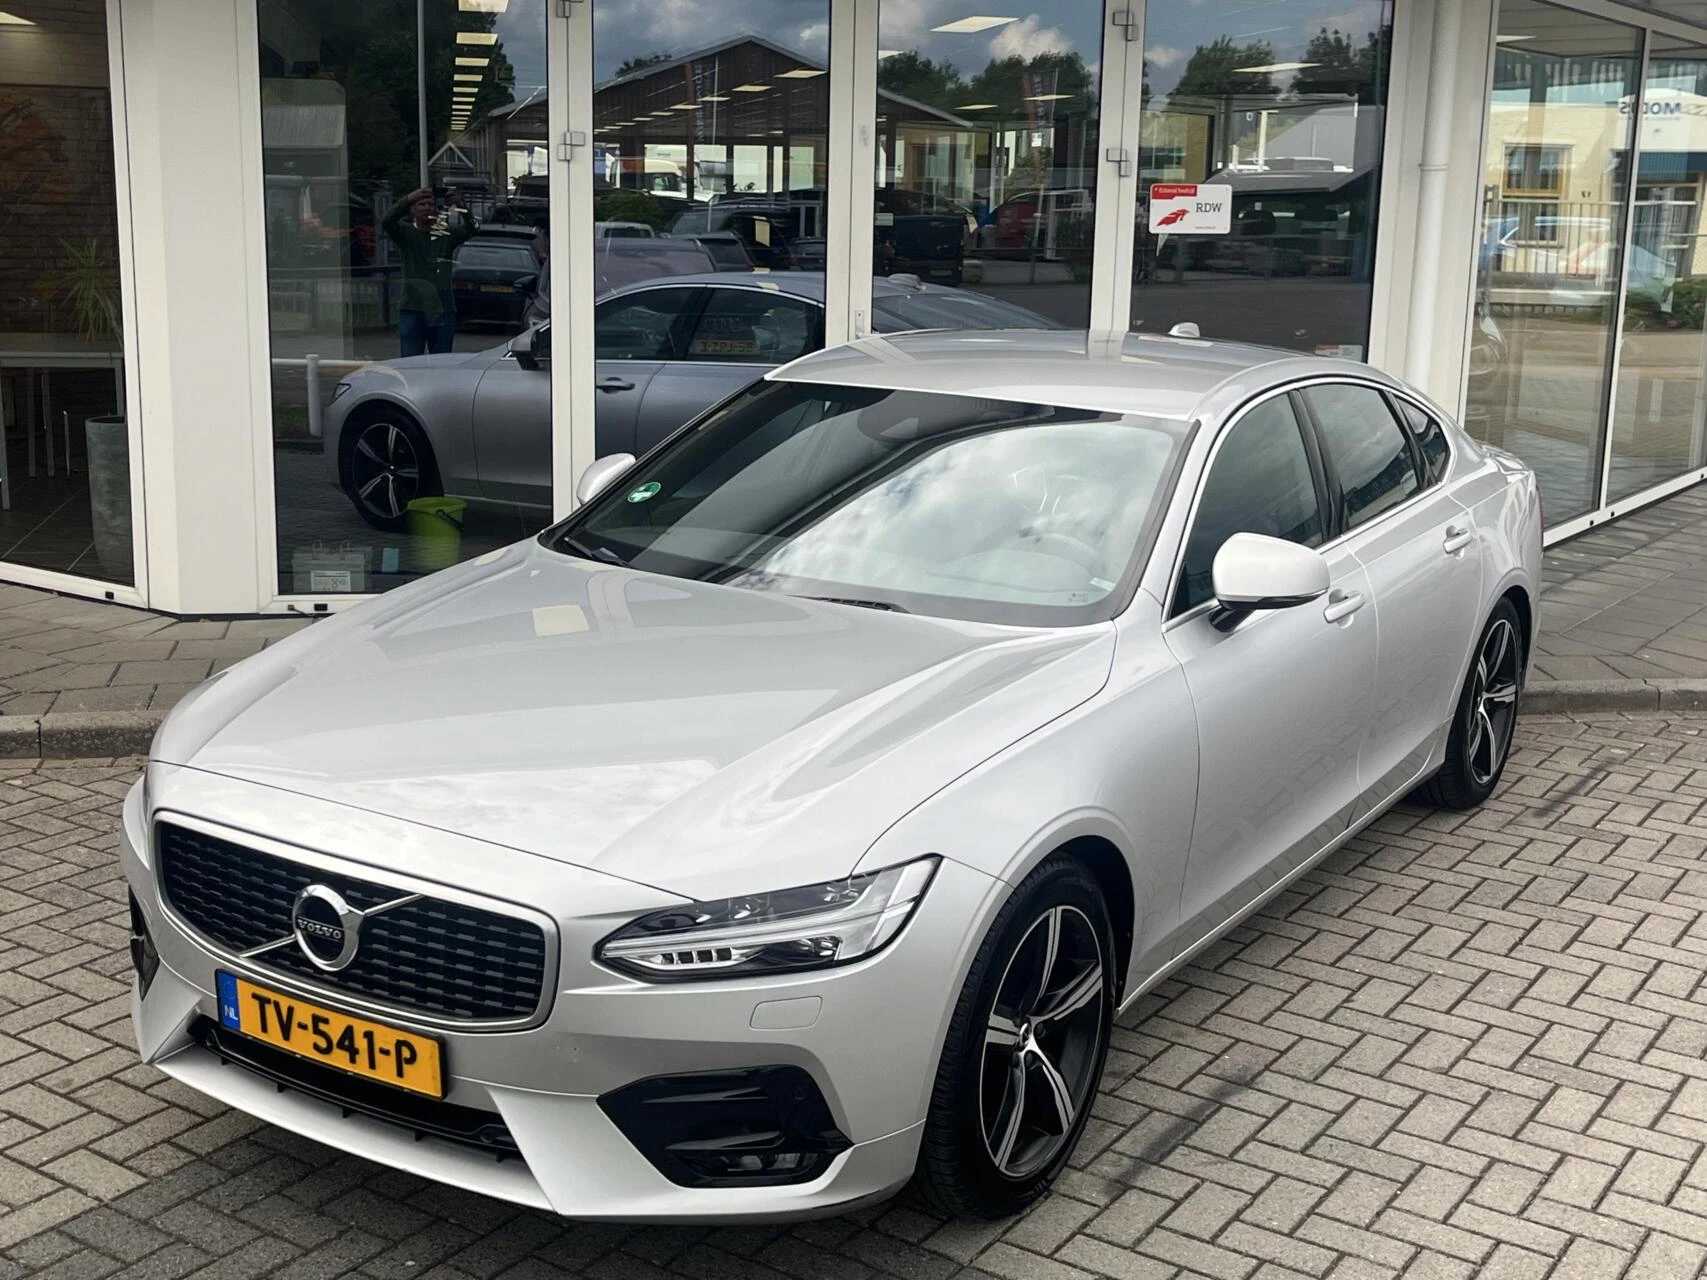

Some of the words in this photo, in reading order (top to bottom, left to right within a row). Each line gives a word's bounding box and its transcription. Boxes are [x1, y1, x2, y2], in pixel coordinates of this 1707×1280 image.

[1196, 202, 1222, 213] RDW
[296, 919, 342, 939] VOLVO
[224, 1004, 239, 1021] NL
[251, 992, 417, 1079] TV-541-P
